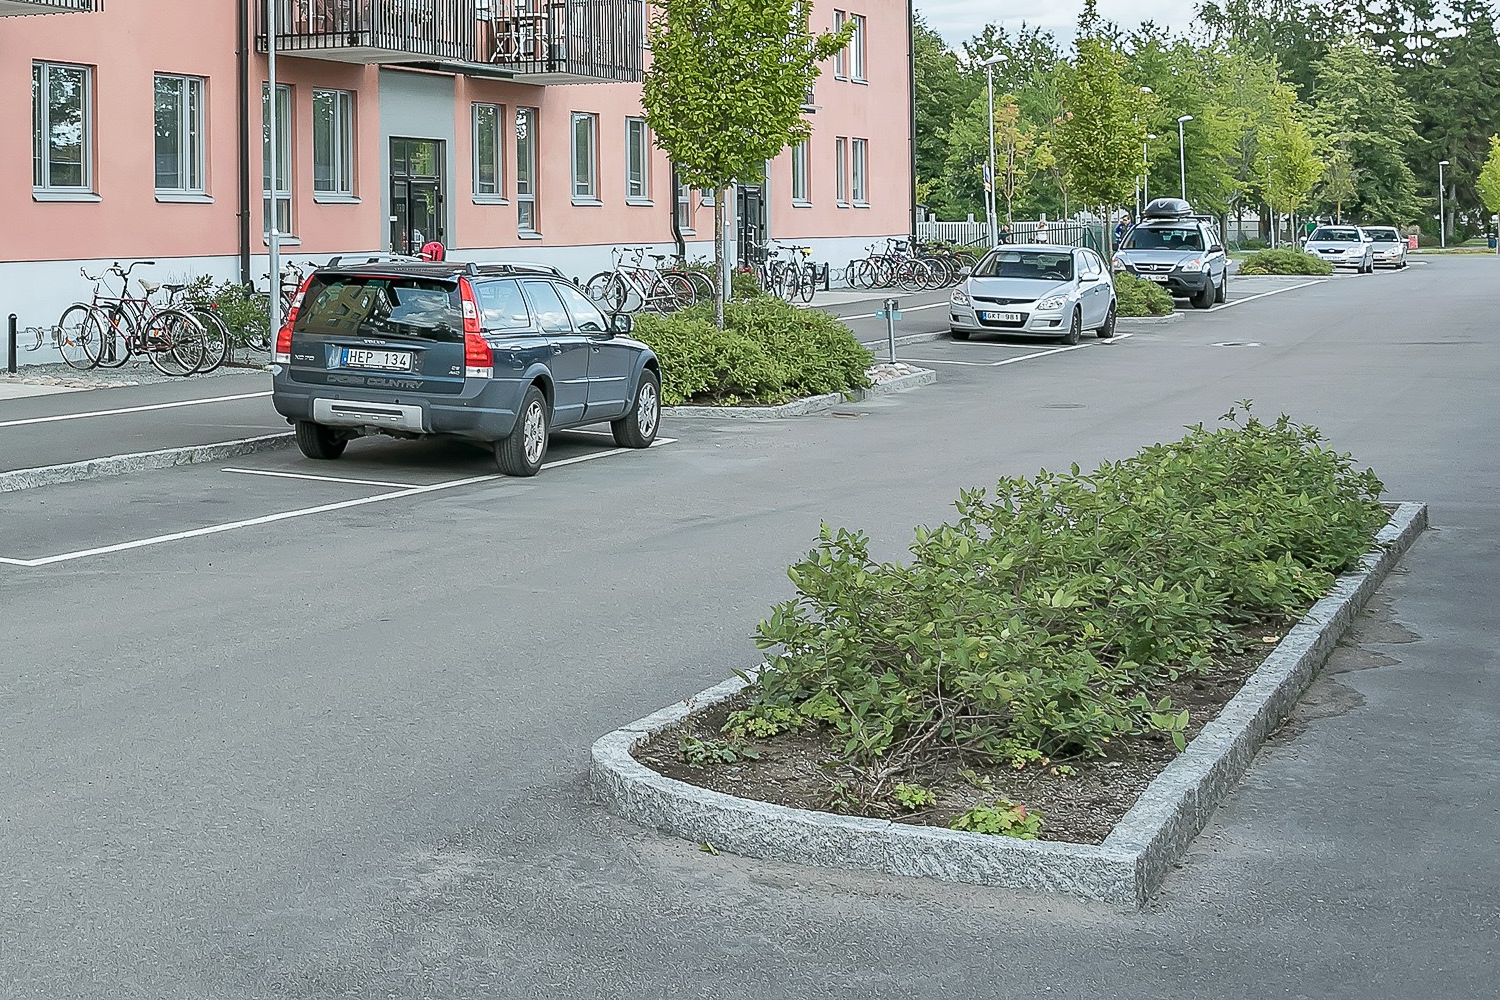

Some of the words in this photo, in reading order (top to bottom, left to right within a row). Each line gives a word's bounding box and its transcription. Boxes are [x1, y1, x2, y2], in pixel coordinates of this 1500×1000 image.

[349, 350, 374, 363] HEP
[384, 352, 407, 366] 134
[366, 377, 423, 389] COUNTRY
